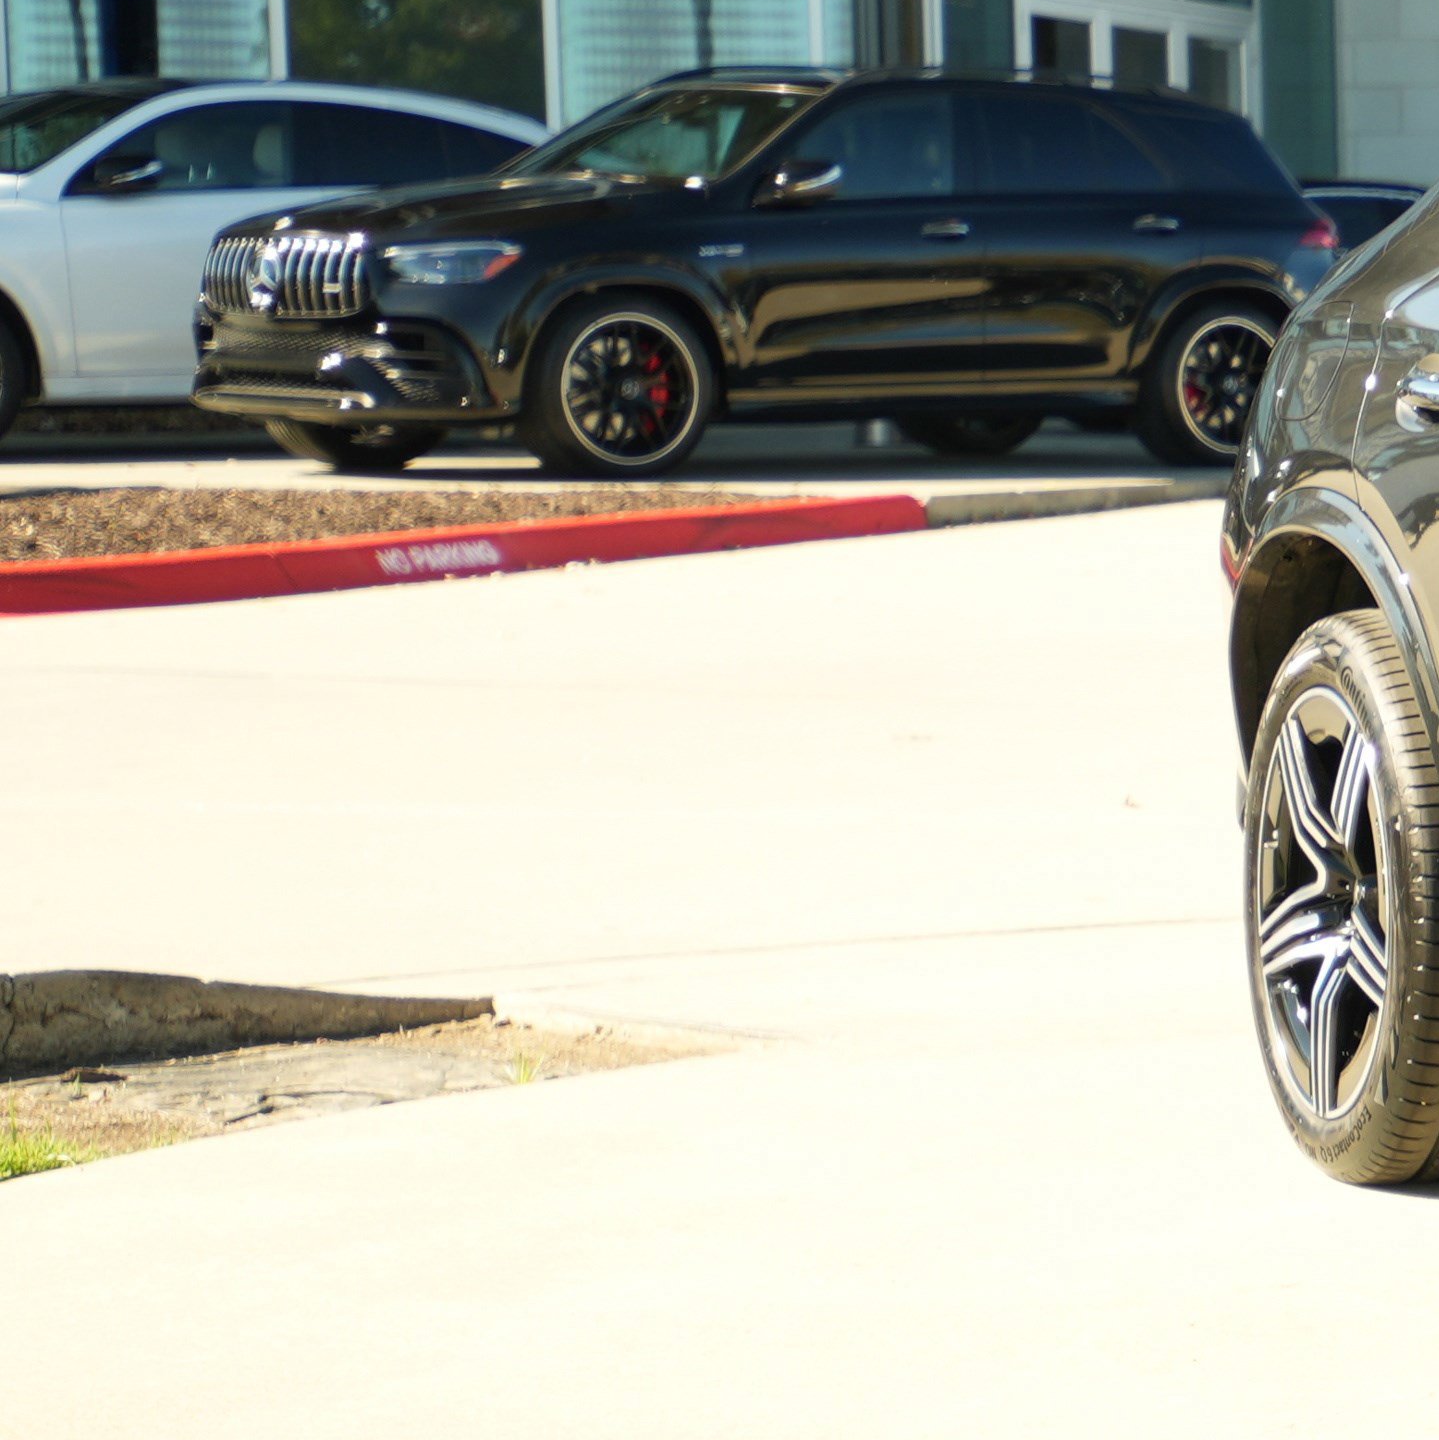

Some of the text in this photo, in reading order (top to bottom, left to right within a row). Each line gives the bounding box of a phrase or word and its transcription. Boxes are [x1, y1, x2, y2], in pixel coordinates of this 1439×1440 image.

[375, 539, 500, 576] NO PARKING
[1332, 1103, 1372, 1160] EcoContact
